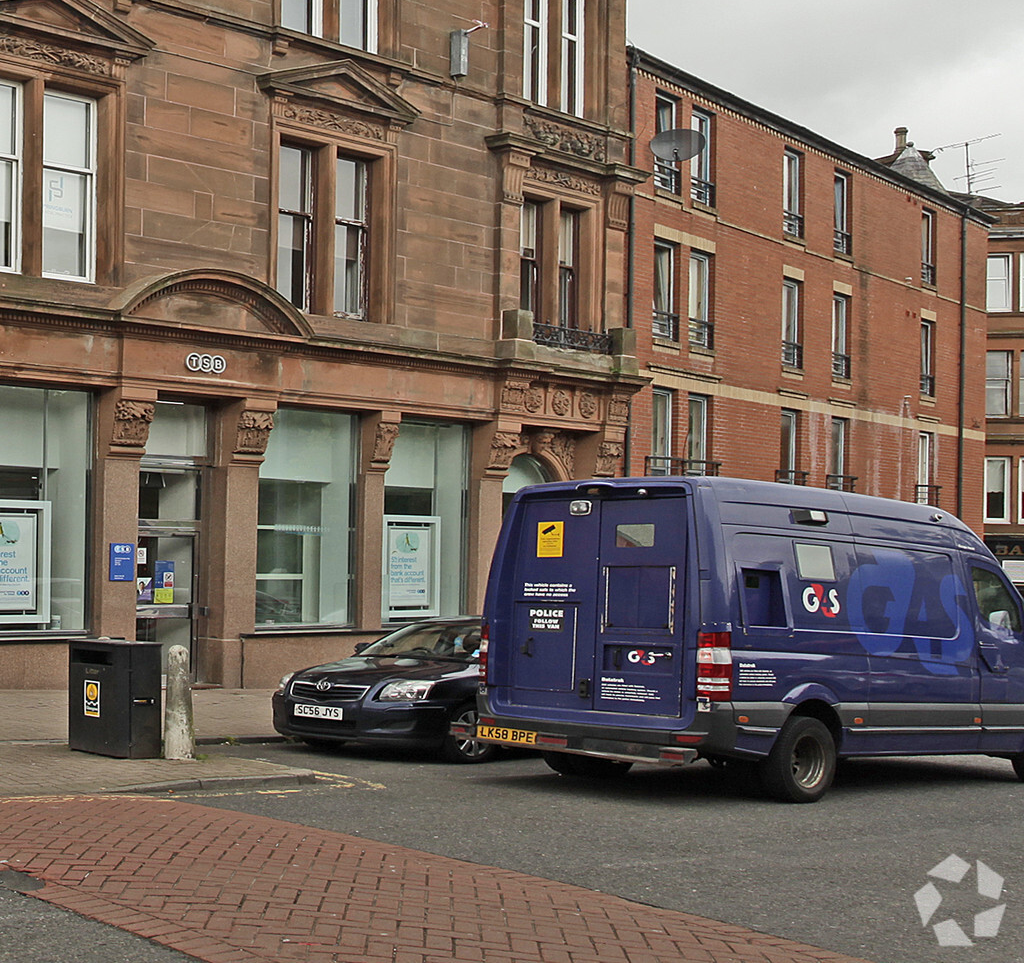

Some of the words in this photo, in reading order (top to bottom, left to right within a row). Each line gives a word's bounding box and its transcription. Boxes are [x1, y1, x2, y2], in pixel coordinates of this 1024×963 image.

[189, 356, 223, 370] TSB
[802, 583, 840, 618] G4S
[529, 609, 564, 617] POLICE
[846, 549, 974, 675] G4S
[627, 649, 656, 666] G4S
[297, 705, 320, 715] SC56
[322, 707, 339, 717] JYS
[480, 726, 508, 740] LK58
[511, 730, 533, 743] BPE
